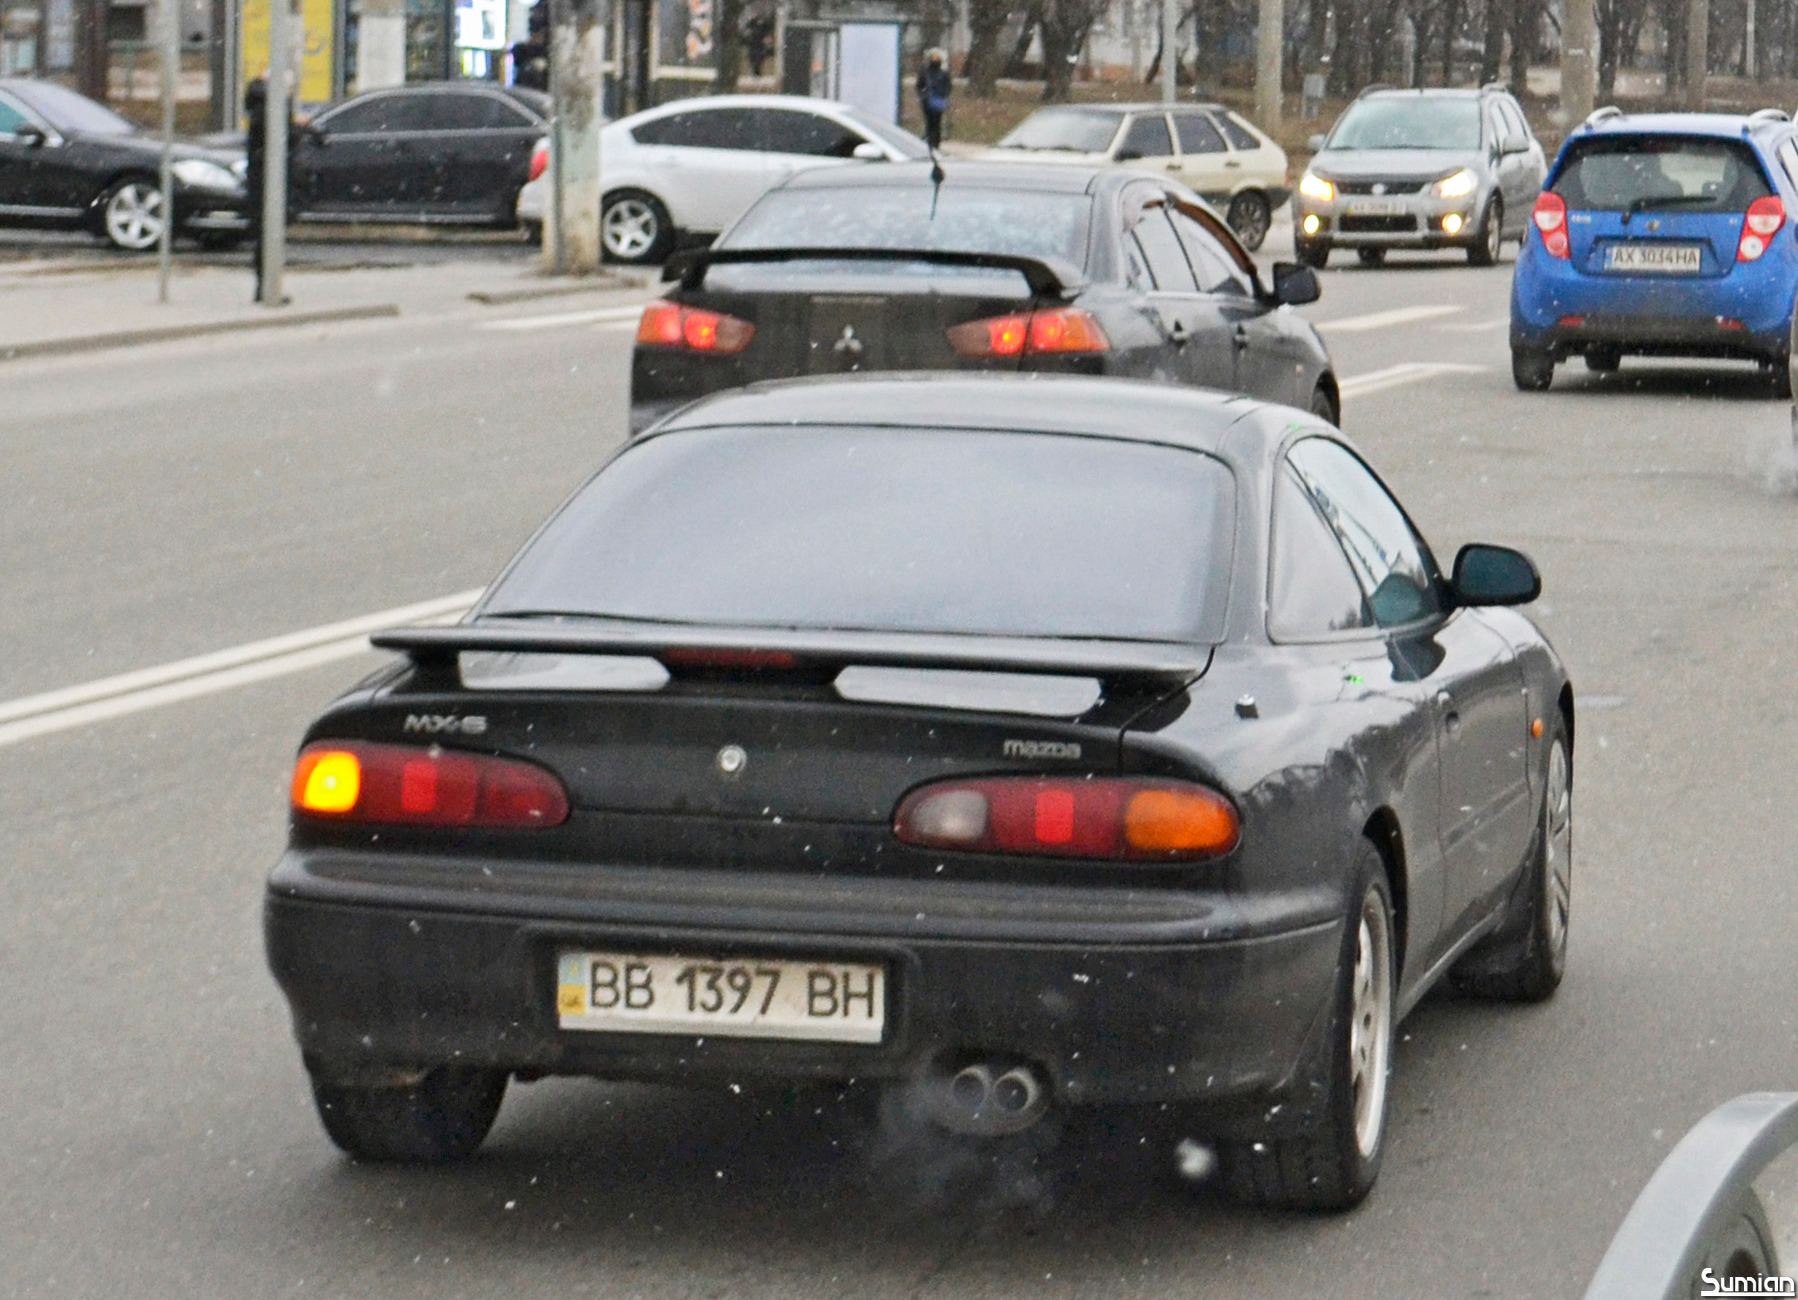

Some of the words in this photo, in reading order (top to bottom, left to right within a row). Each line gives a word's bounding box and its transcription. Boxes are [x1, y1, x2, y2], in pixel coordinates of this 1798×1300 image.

[1614, 247, 1635, 263] AX
[591, 961, 655, 1010] BB
[676, 964, 781, 1015] 1397
[807, 970, 875, 1018] BH
